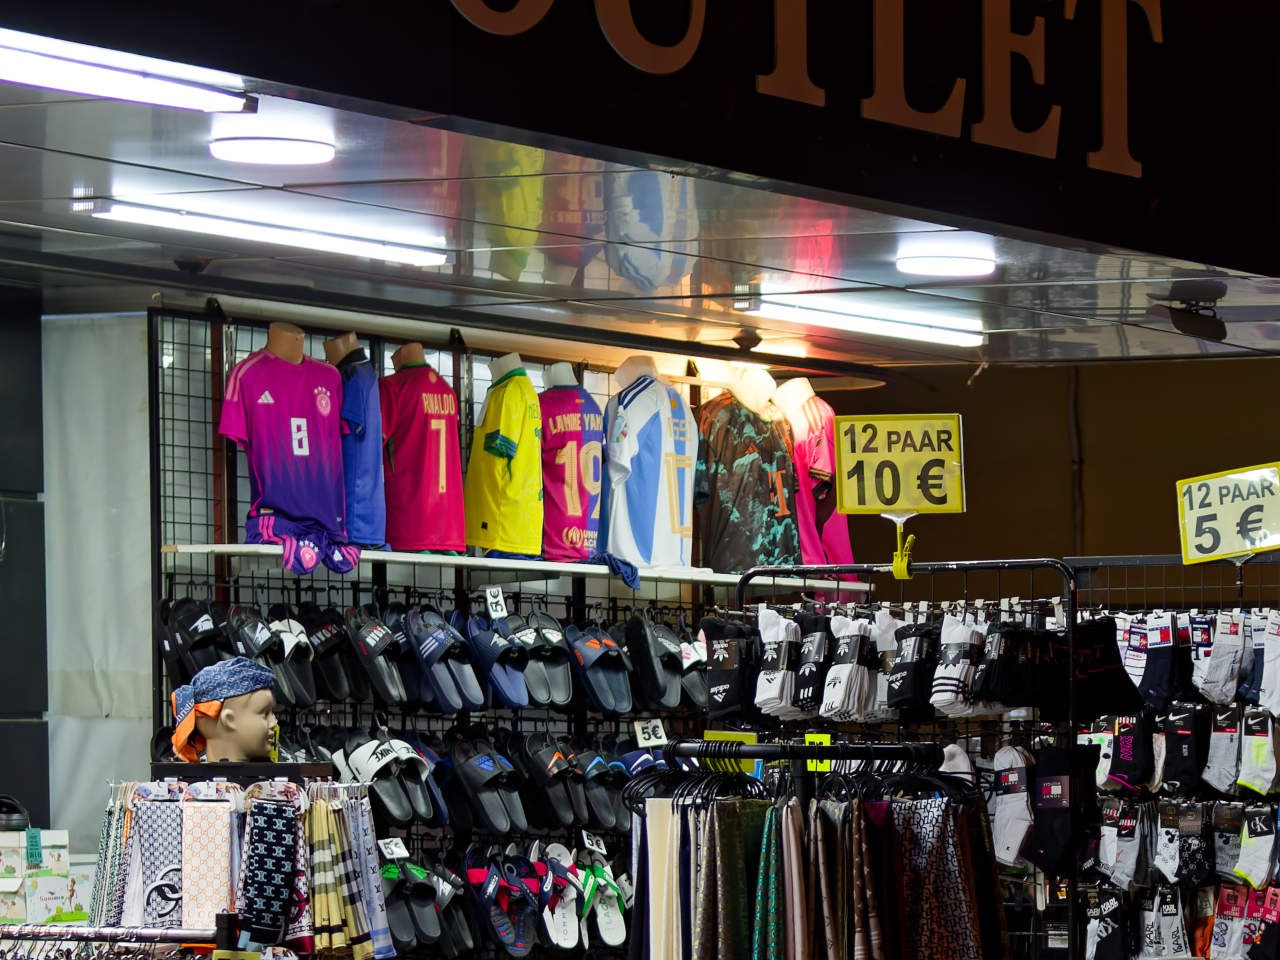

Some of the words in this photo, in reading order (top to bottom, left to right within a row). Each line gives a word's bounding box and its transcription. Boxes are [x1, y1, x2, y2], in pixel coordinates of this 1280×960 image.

[291, 417, 310, 456] 8
[844, 423, 879, 453] 12
[887, 429, 954, 453] PAAR
[430, 419, 447, 493] 7
[555, 441, 602, 519] 19
[846, 460, 901, 506] 10
[916, 458, 948, 505] €
[1182, 482, 1212, 511] 12
[1218, 476, 1275, 505] PAAR
[1194, 513, 1221, 554] 5
[1236, 504, 1268, 546] €
[489, 588, 504, 613] 5€
[641, 725, 662, 741] 5€
[374, 748, 392, 763] NIKE
